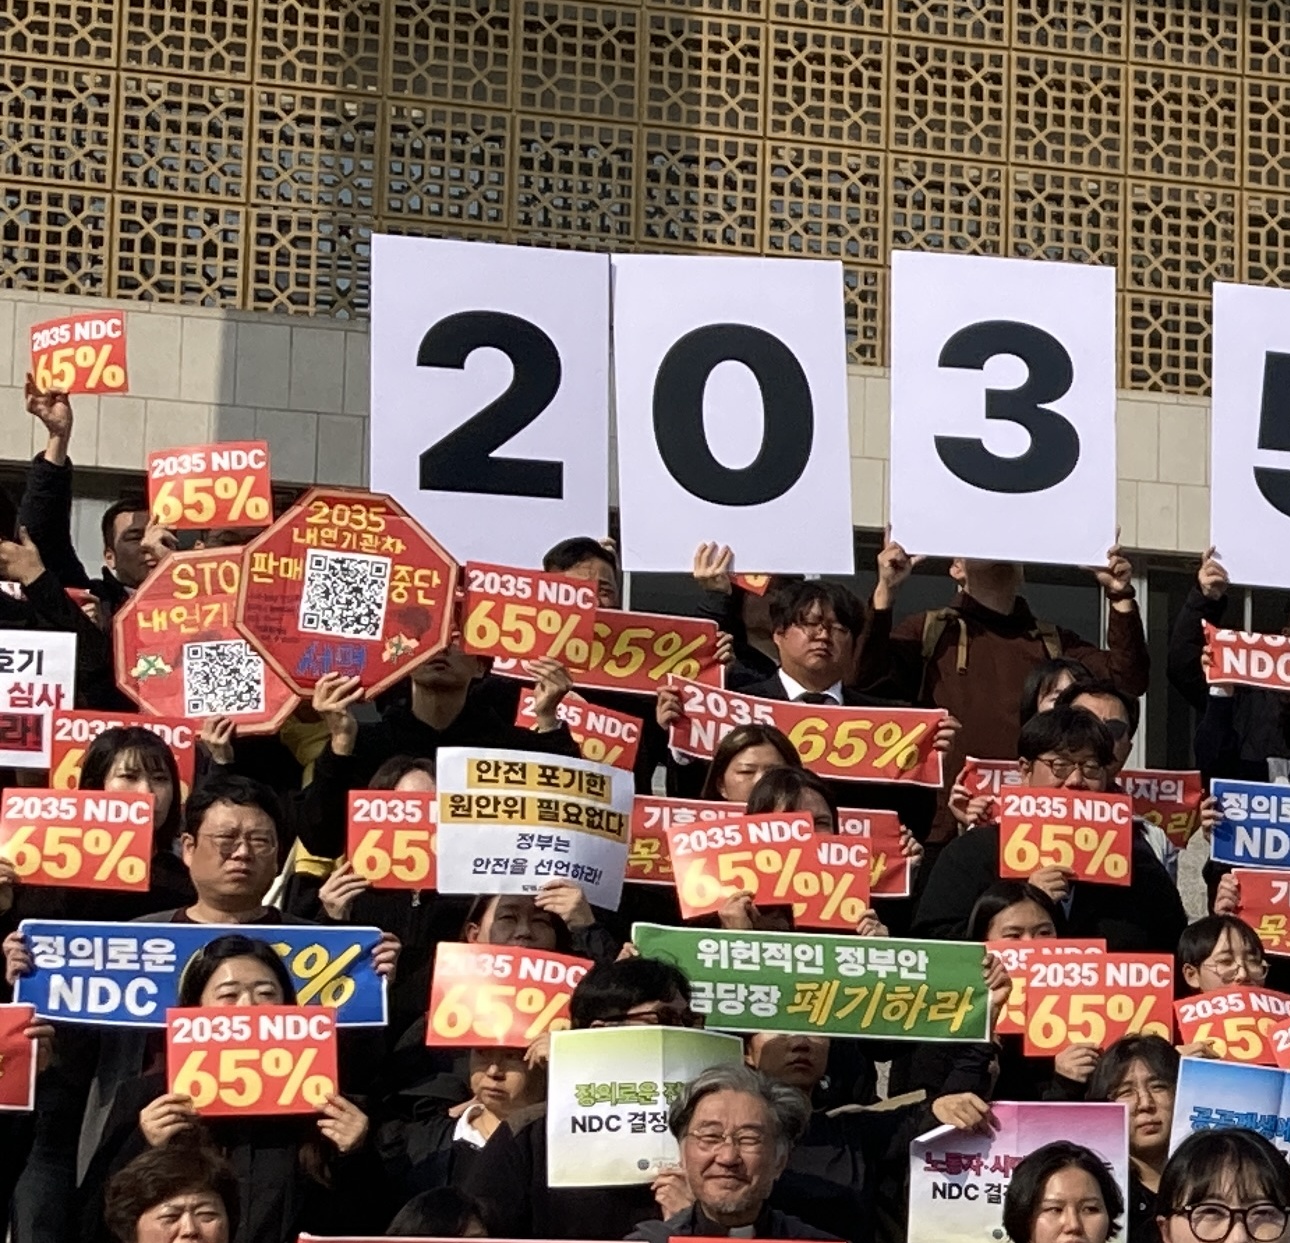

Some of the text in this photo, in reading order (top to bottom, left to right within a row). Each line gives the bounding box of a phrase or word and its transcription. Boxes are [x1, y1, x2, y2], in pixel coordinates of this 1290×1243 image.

[32, 318, 122, 351] 2035 NDC
[35, 344, 125, 393] 65%
[151, 449, 267, 479] 2035 NDC
[153, 476, 269, 526] 65%
[306, 501, 386, 532] 2035
[293, 526, 406, 555] 내연기관차
[250, 551, 441, 605] 판매 중단
[469, 569, 594, 610] 2035 NDC
[464, 600, 592, 666] 65%
[788, 716, 928, 770] 65%
[476, 759, 606, 797] 안전 포기한
[5, 797, 150, 824] 2035 NDC
[449, 794, 624, 837] 원안위 필요없다
[1004, 795, 1130, 824] 2035 NDC
[516, 833, 571, 852] 정부는
[747, 818, 812, 845] NDC
[1004, 822, 1129, 879] 65%
[4, 825, 147, 884] 65%
[472, 858, 602, 886] 안전을 선언하라!
[681, 848, 803, 908] 65%
[32, 935, 176, 972] 정의로운
[696, 938, 929, 981] 위헌적인 정부안
[1030, 962, 1171, 988] 2035 NDC
[49, 975, 158, 1016] NDC
[787, 978, 975, 1034] 폐기하라
[172, 1014, 333, 1044] 2035 NDC
[172, 1047, 334, 1109] 65%
[575, 1081, 660, 1107] 정의로운
[571, 1114, 622, 1134] NDC
